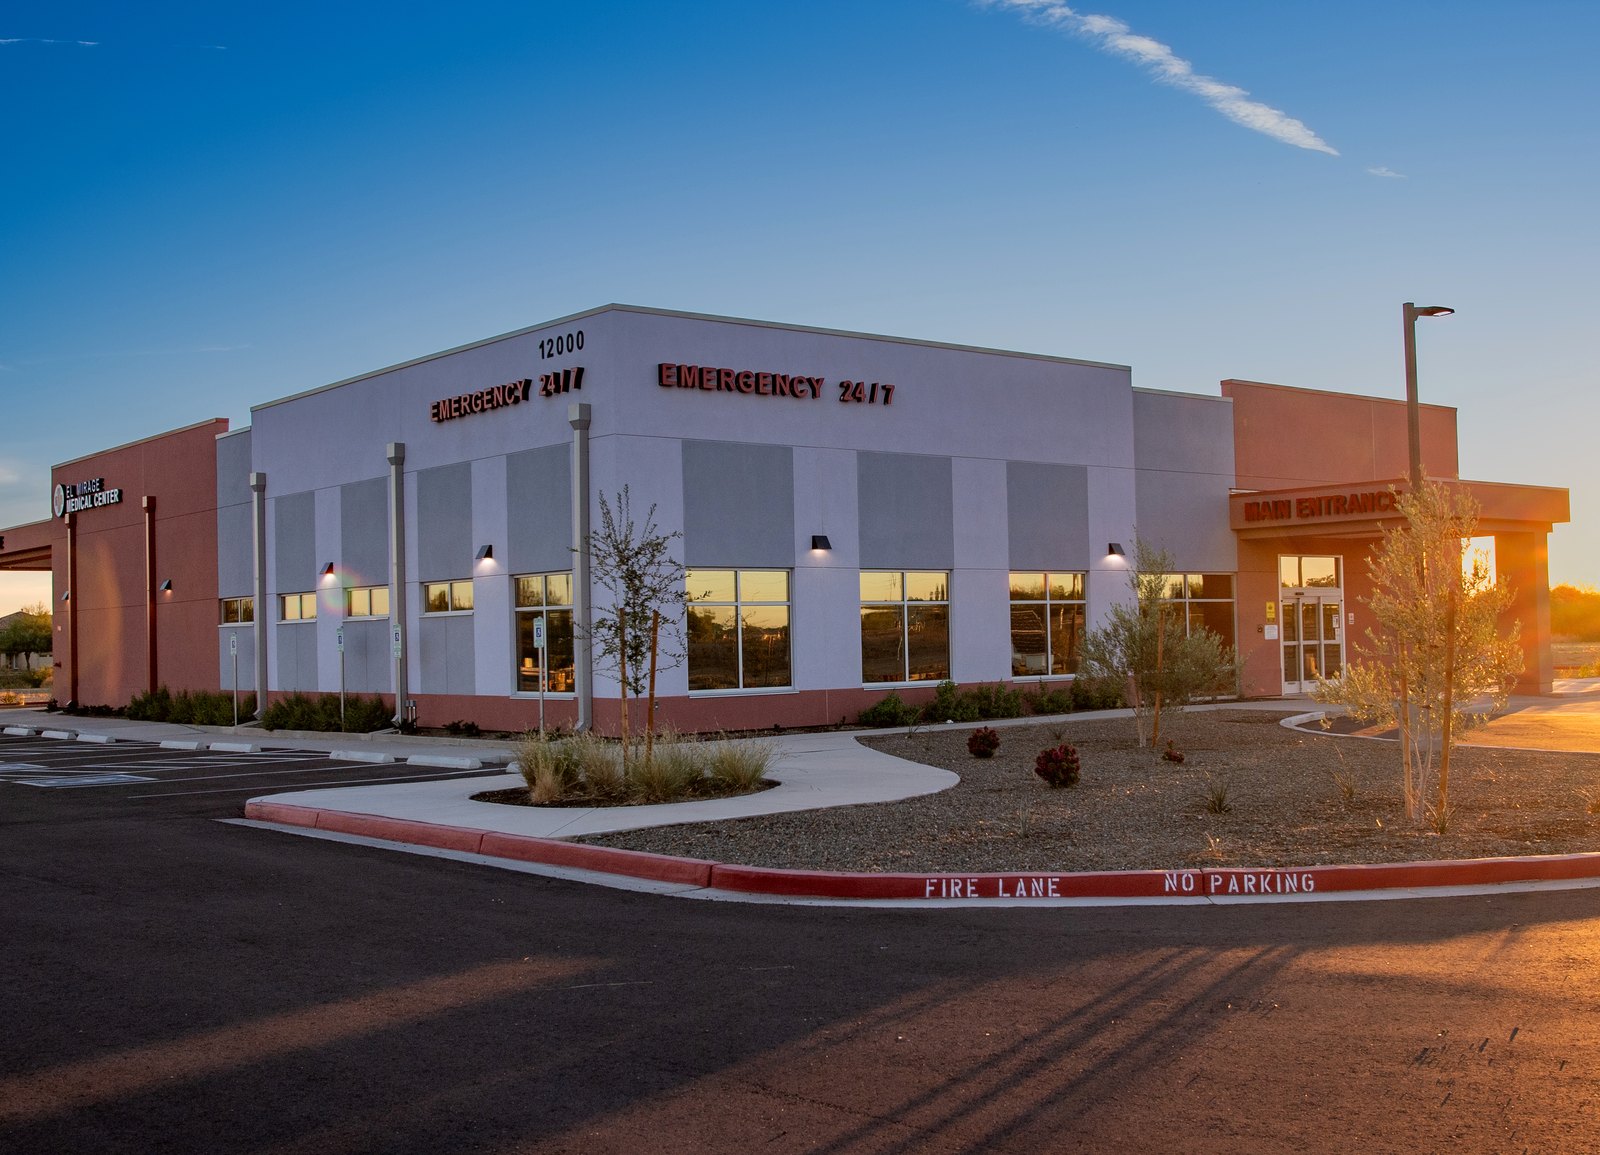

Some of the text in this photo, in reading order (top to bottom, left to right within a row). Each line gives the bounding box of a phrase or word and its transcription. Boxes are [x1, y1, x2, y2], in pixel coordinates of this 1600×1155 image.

[539, 330, 585, 360] 12000
[431, 367, 585, 423] EMERGENCY 24/7
[658, 363, 895, 405] EMERGENCY 24/7
[66, 478, 101, 499] EL MIRAGE
[66, 488, 119, 513] MEDICAL CENTER
[1245, 500, 1291, 521] MAIN
[926, 878, 1061, 898] FIRE LANE
[1164, 872, 1316, 894] NO PARKING
